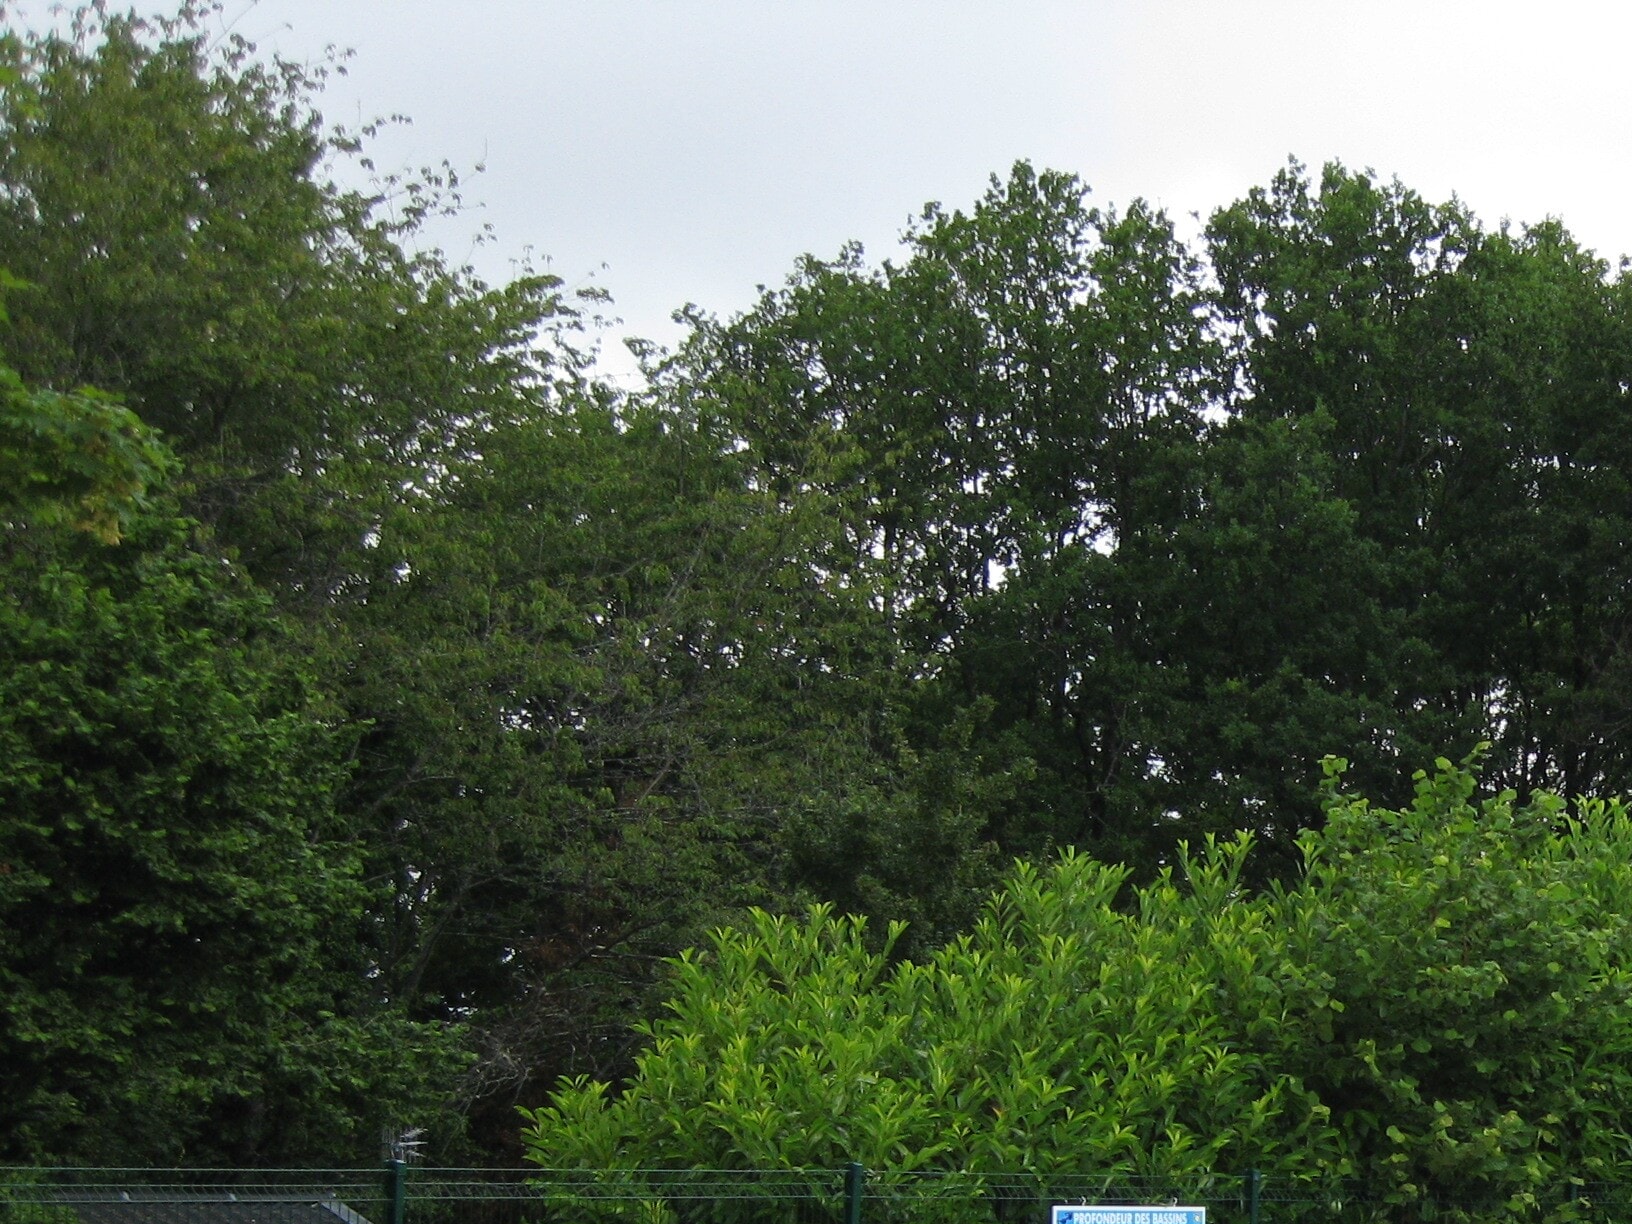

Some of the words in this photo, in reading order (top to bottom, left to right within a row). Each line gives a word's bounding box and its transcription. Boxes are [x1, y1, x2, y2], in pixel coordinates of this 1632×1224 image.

[1073, 1212, 1132, 1224] PROFONDEUR
[1134, 1212, 1150, 1224] DES
[1152, 1212, 1187, 1224] BASSINS
